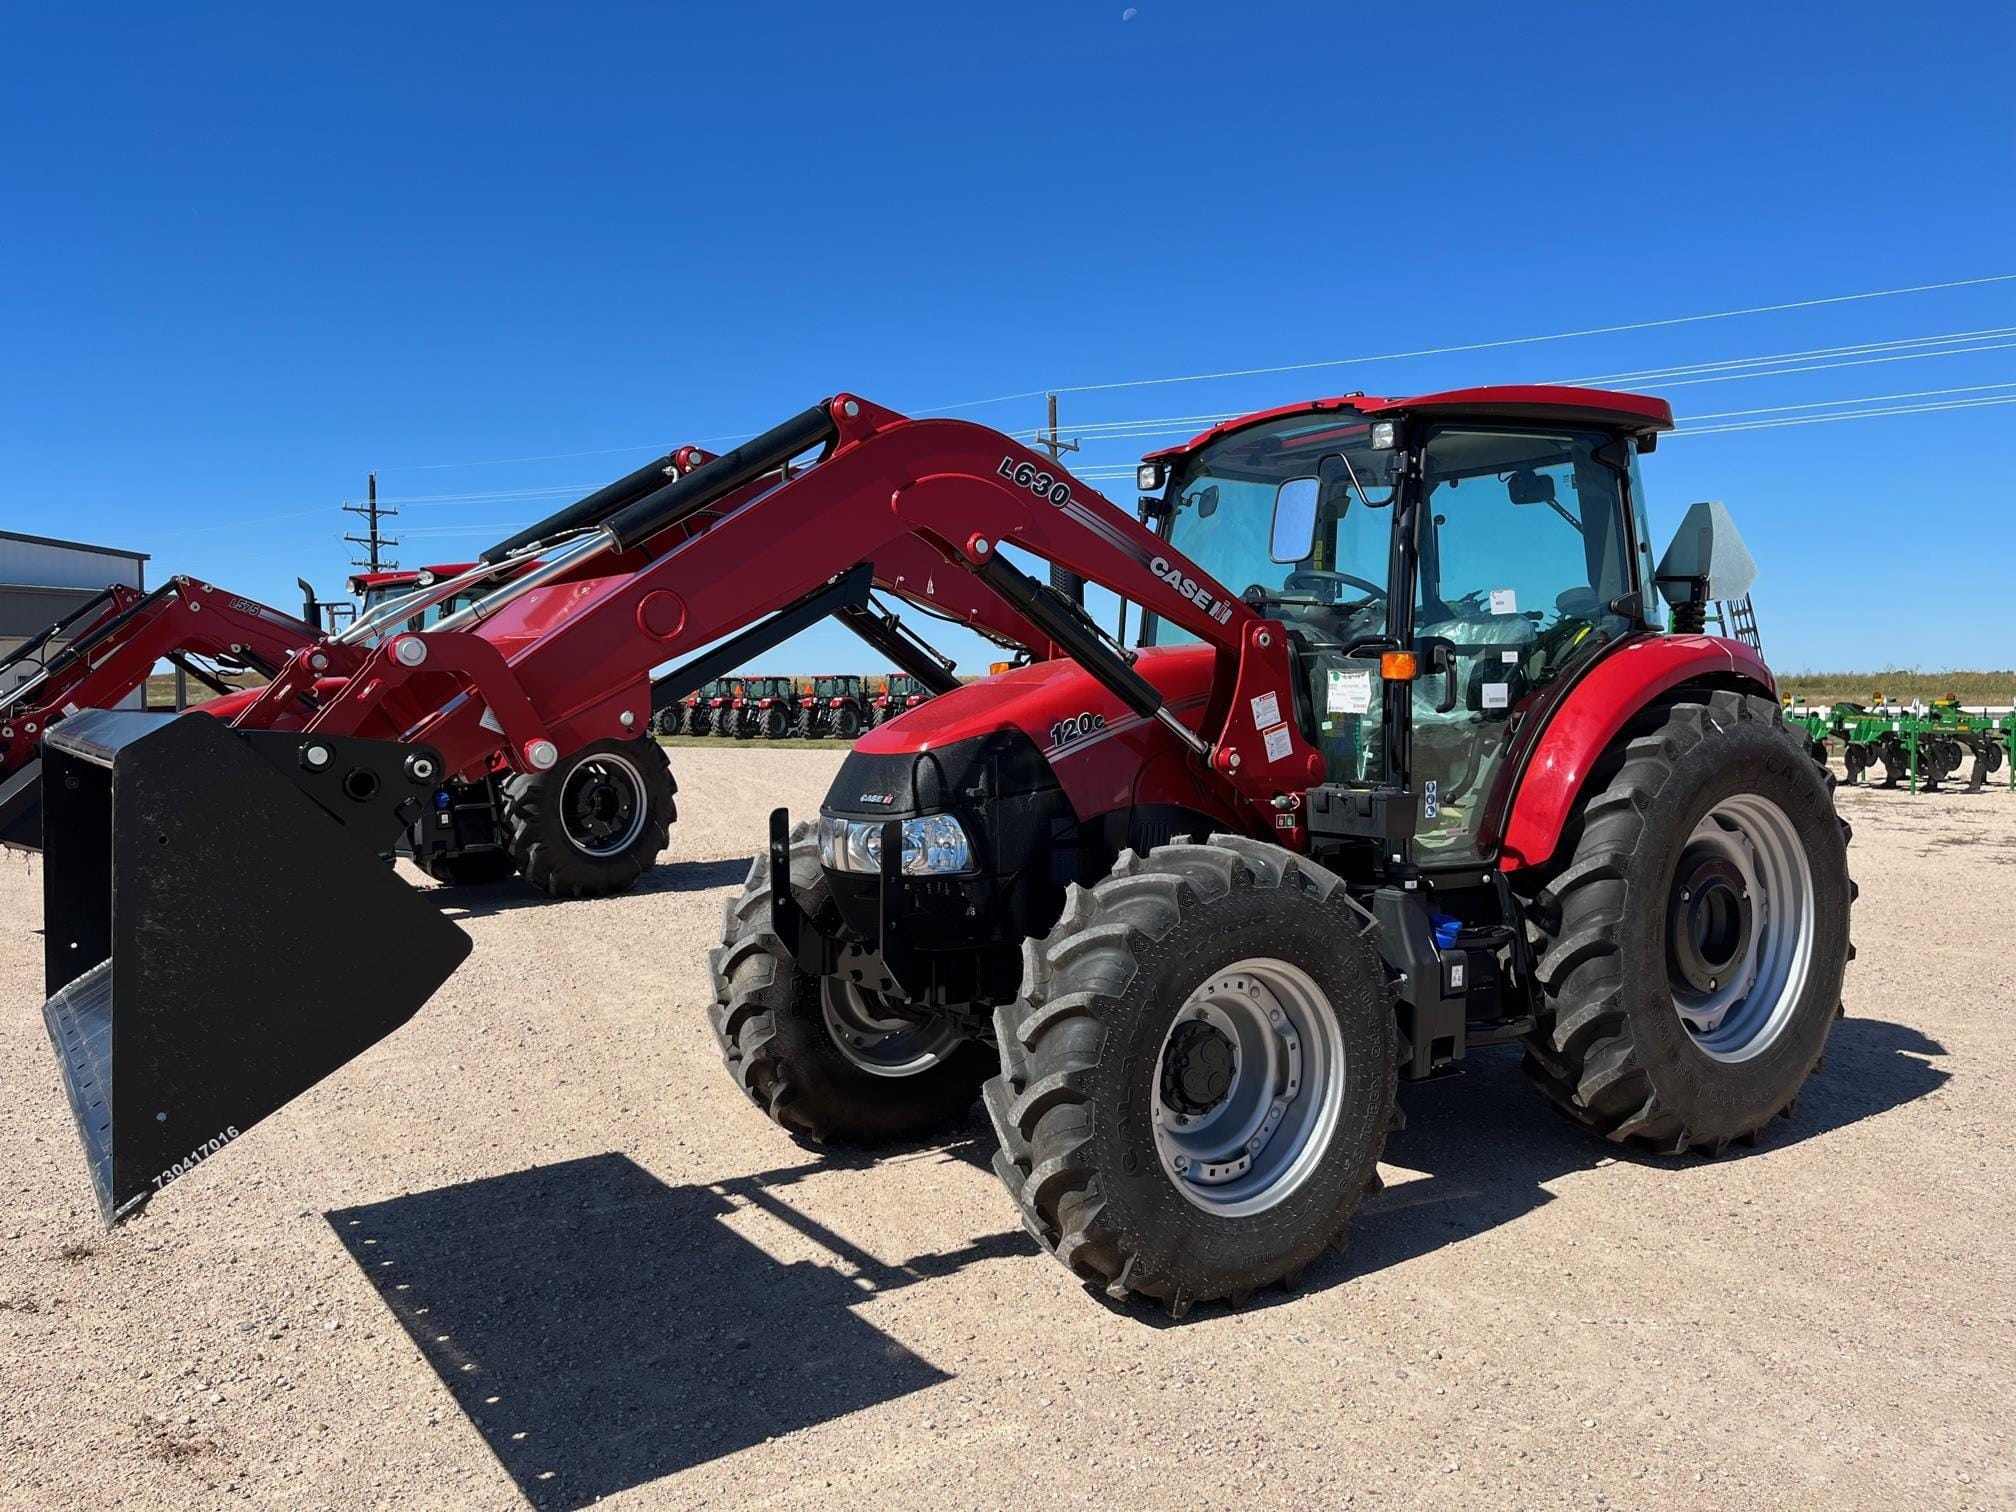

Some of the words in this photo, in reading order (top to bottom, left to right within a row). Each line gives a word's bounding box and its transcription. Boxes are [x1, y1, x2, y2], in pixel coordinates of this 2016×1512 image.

[996, 456, 1071, 507] L630
[229, 598, 261, 616] L575
[1150, 556, 1213, 611] CASE
[860, 793, 884, 803] CASE
[151, 1125, 240, 1189] 730417016
